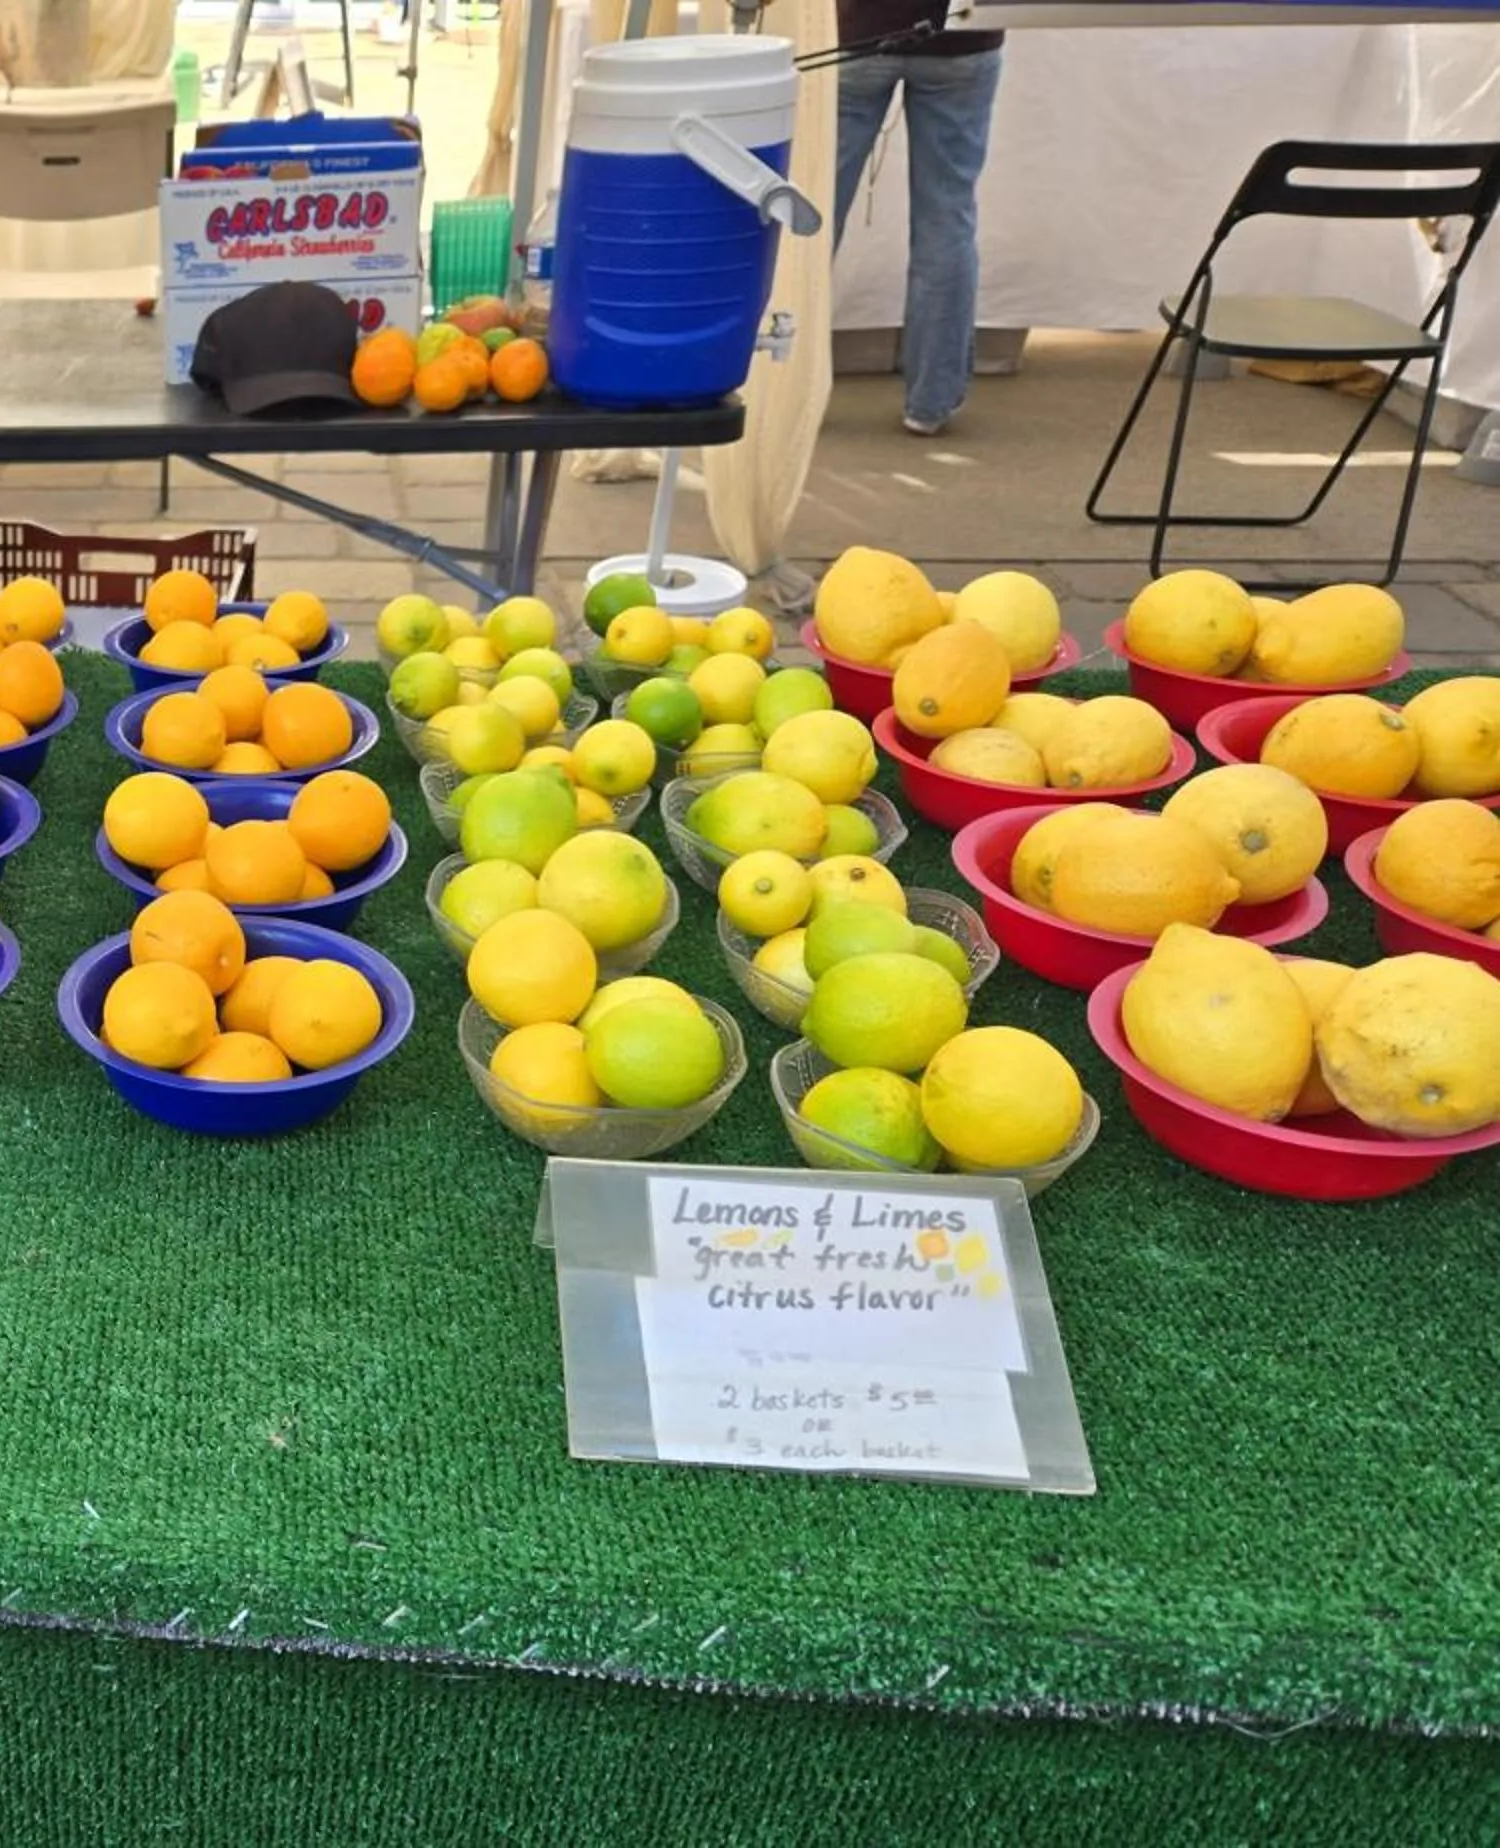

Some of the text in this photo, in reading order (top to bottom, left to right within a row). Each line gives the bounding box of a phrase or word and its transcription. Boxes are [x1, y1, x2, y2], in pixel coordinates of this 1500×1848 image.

[206, 191, 389, 243] CARLSBAD
[672, 1187, 967, 1242] Lemons & Limes
[813, 1242, 931, 1272] fresh
[707, 1280, 815, 1311] citrus
[716, 1384, 740, 1410] 2
[751, 1384, 846, 1412] baskets
[780, 1438, 845, 1459] each
